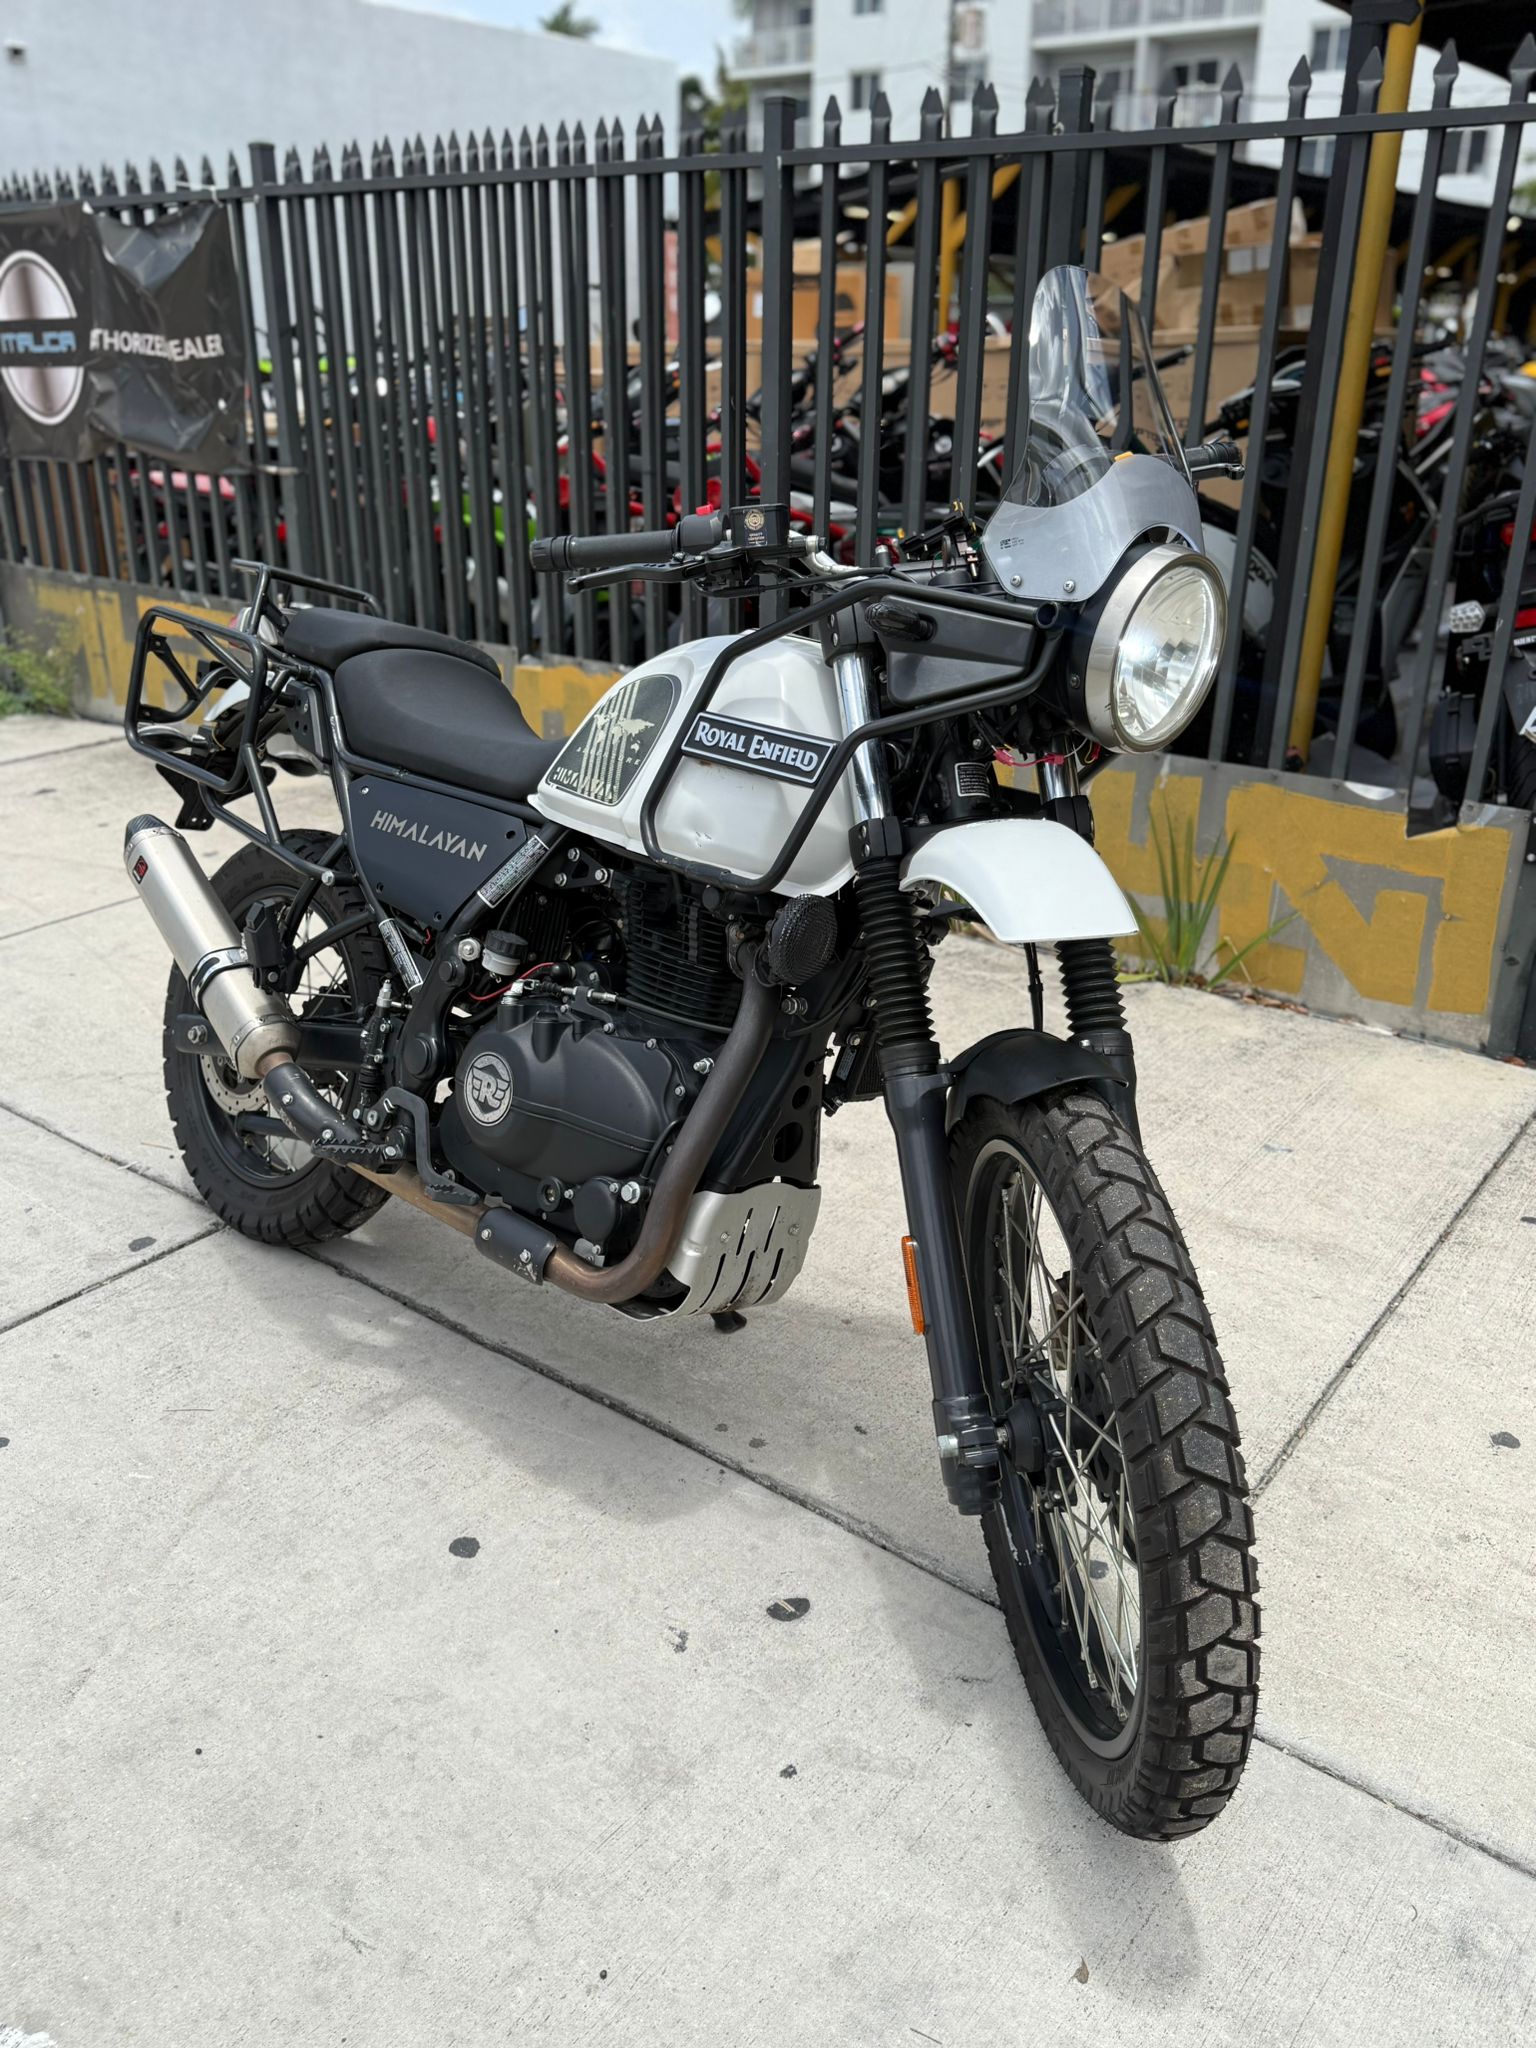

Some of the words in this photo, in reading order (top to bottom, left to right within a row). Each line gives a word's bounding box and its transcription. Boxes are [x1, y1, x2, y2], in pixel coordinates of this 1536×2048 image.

[694, 721, 747, 753] ROYAL
[747, 734, 819, 772] ENFIELD
[370, 810, 488, 863] HIMALAYAN
